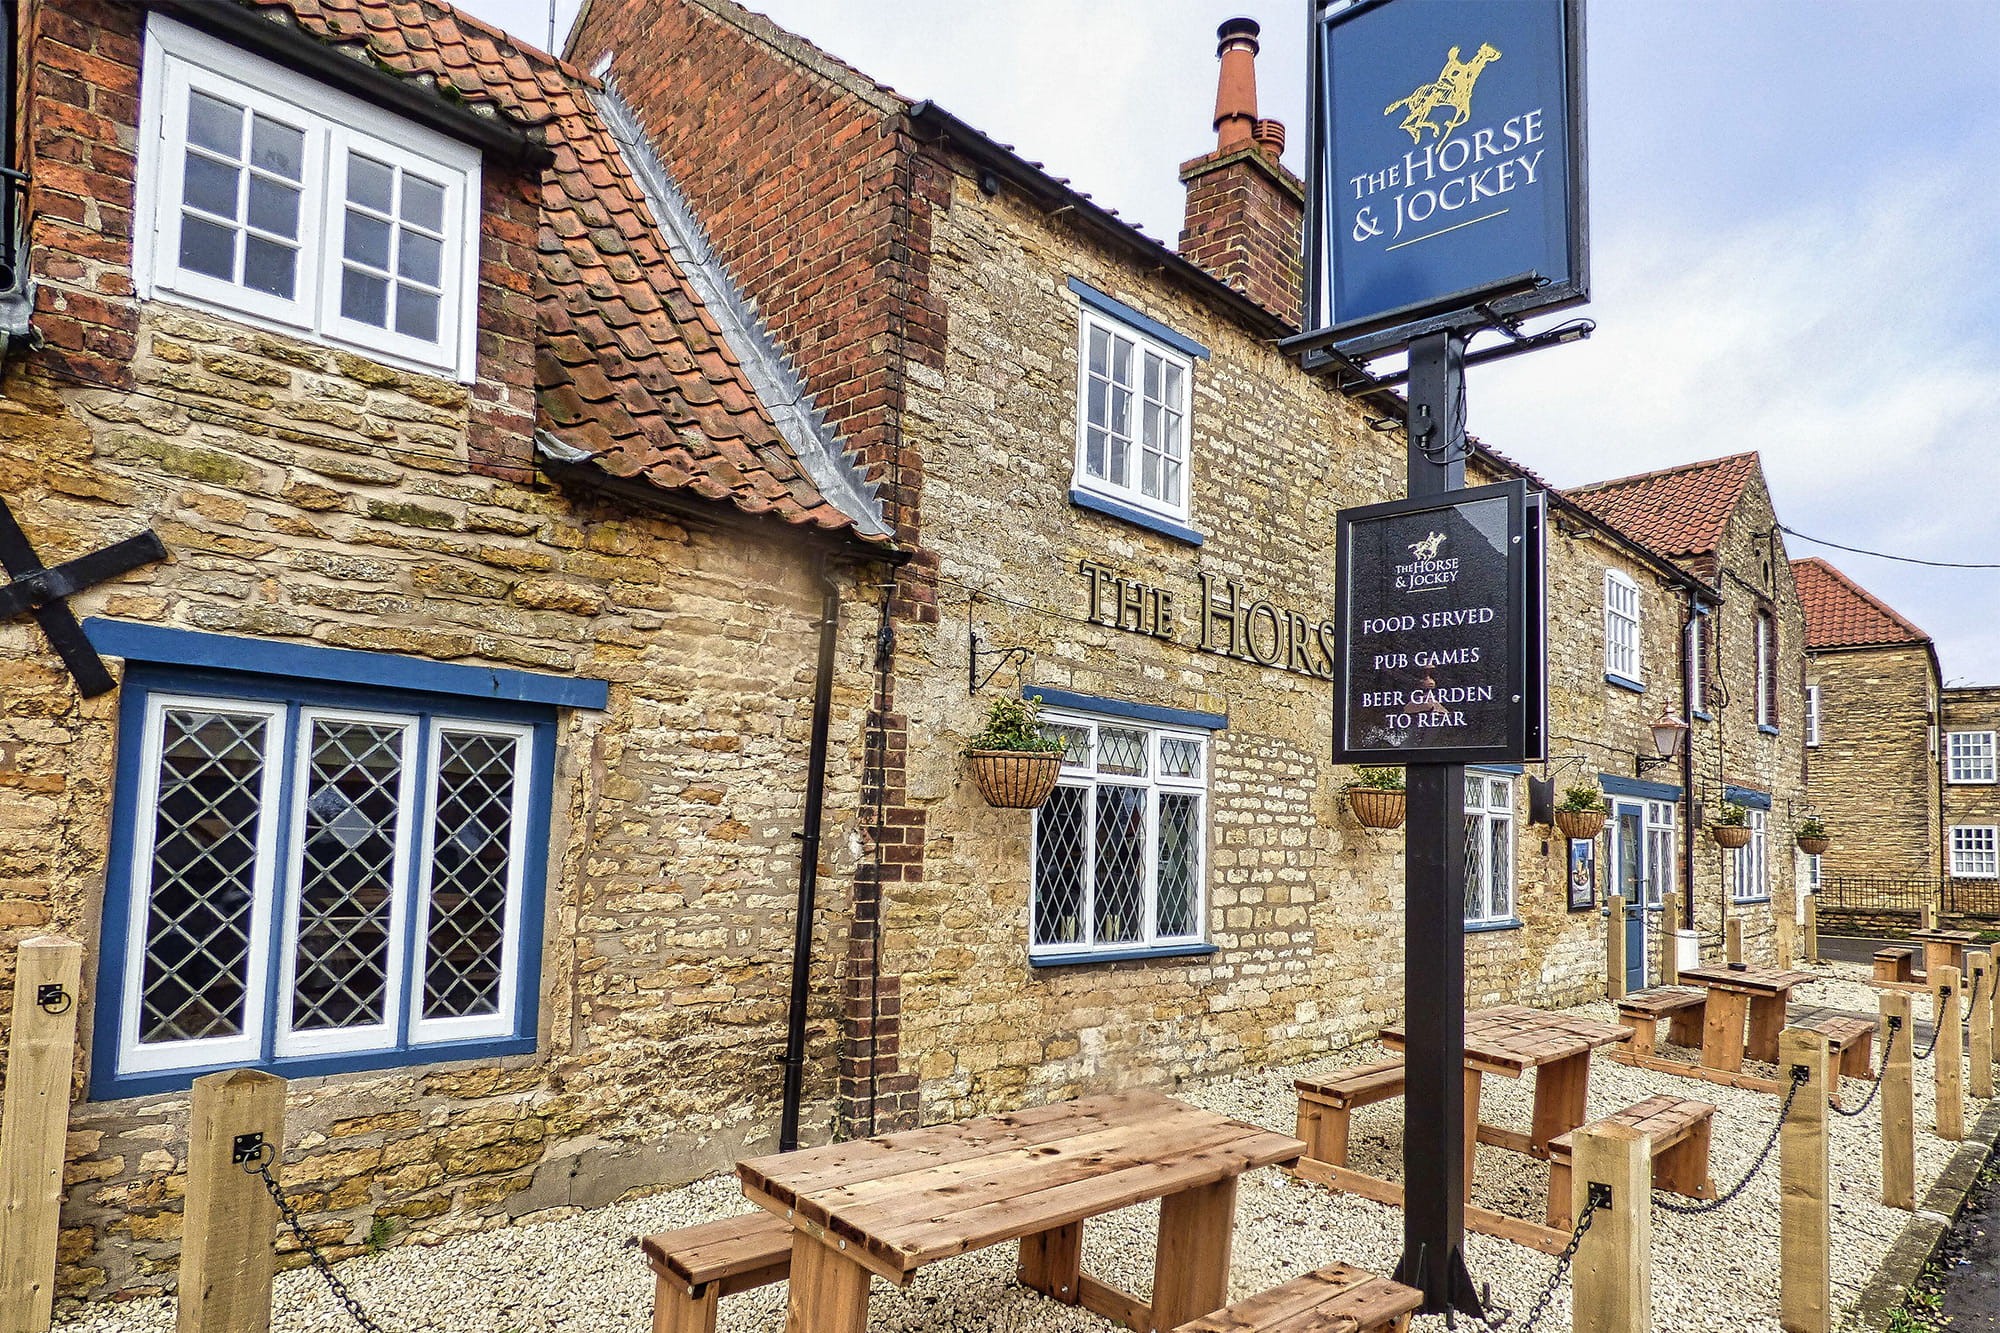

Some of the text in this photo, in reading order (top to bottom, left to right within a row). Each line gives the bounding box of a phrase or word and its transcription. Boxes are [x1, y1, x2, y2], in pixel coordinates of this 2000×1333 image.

[1350, 108, 1545, 200] THE HORSE
[1352, 149, 1545, 242] & JOCKEY
[1395, 558, 1459, 574] THE HORSE
[1395, 570, 1459, 589] & JOCKEY
[1080, 559, 1335, 681] THE HORS
[1363, 607, 1494, 635] FOOD SERVED
[1374, 647, 1480, 670] PUB GAMES
[1362, 685, 1493, 708] BEER GARDEN
[1386, 711, 1468, 729] TO REAR
